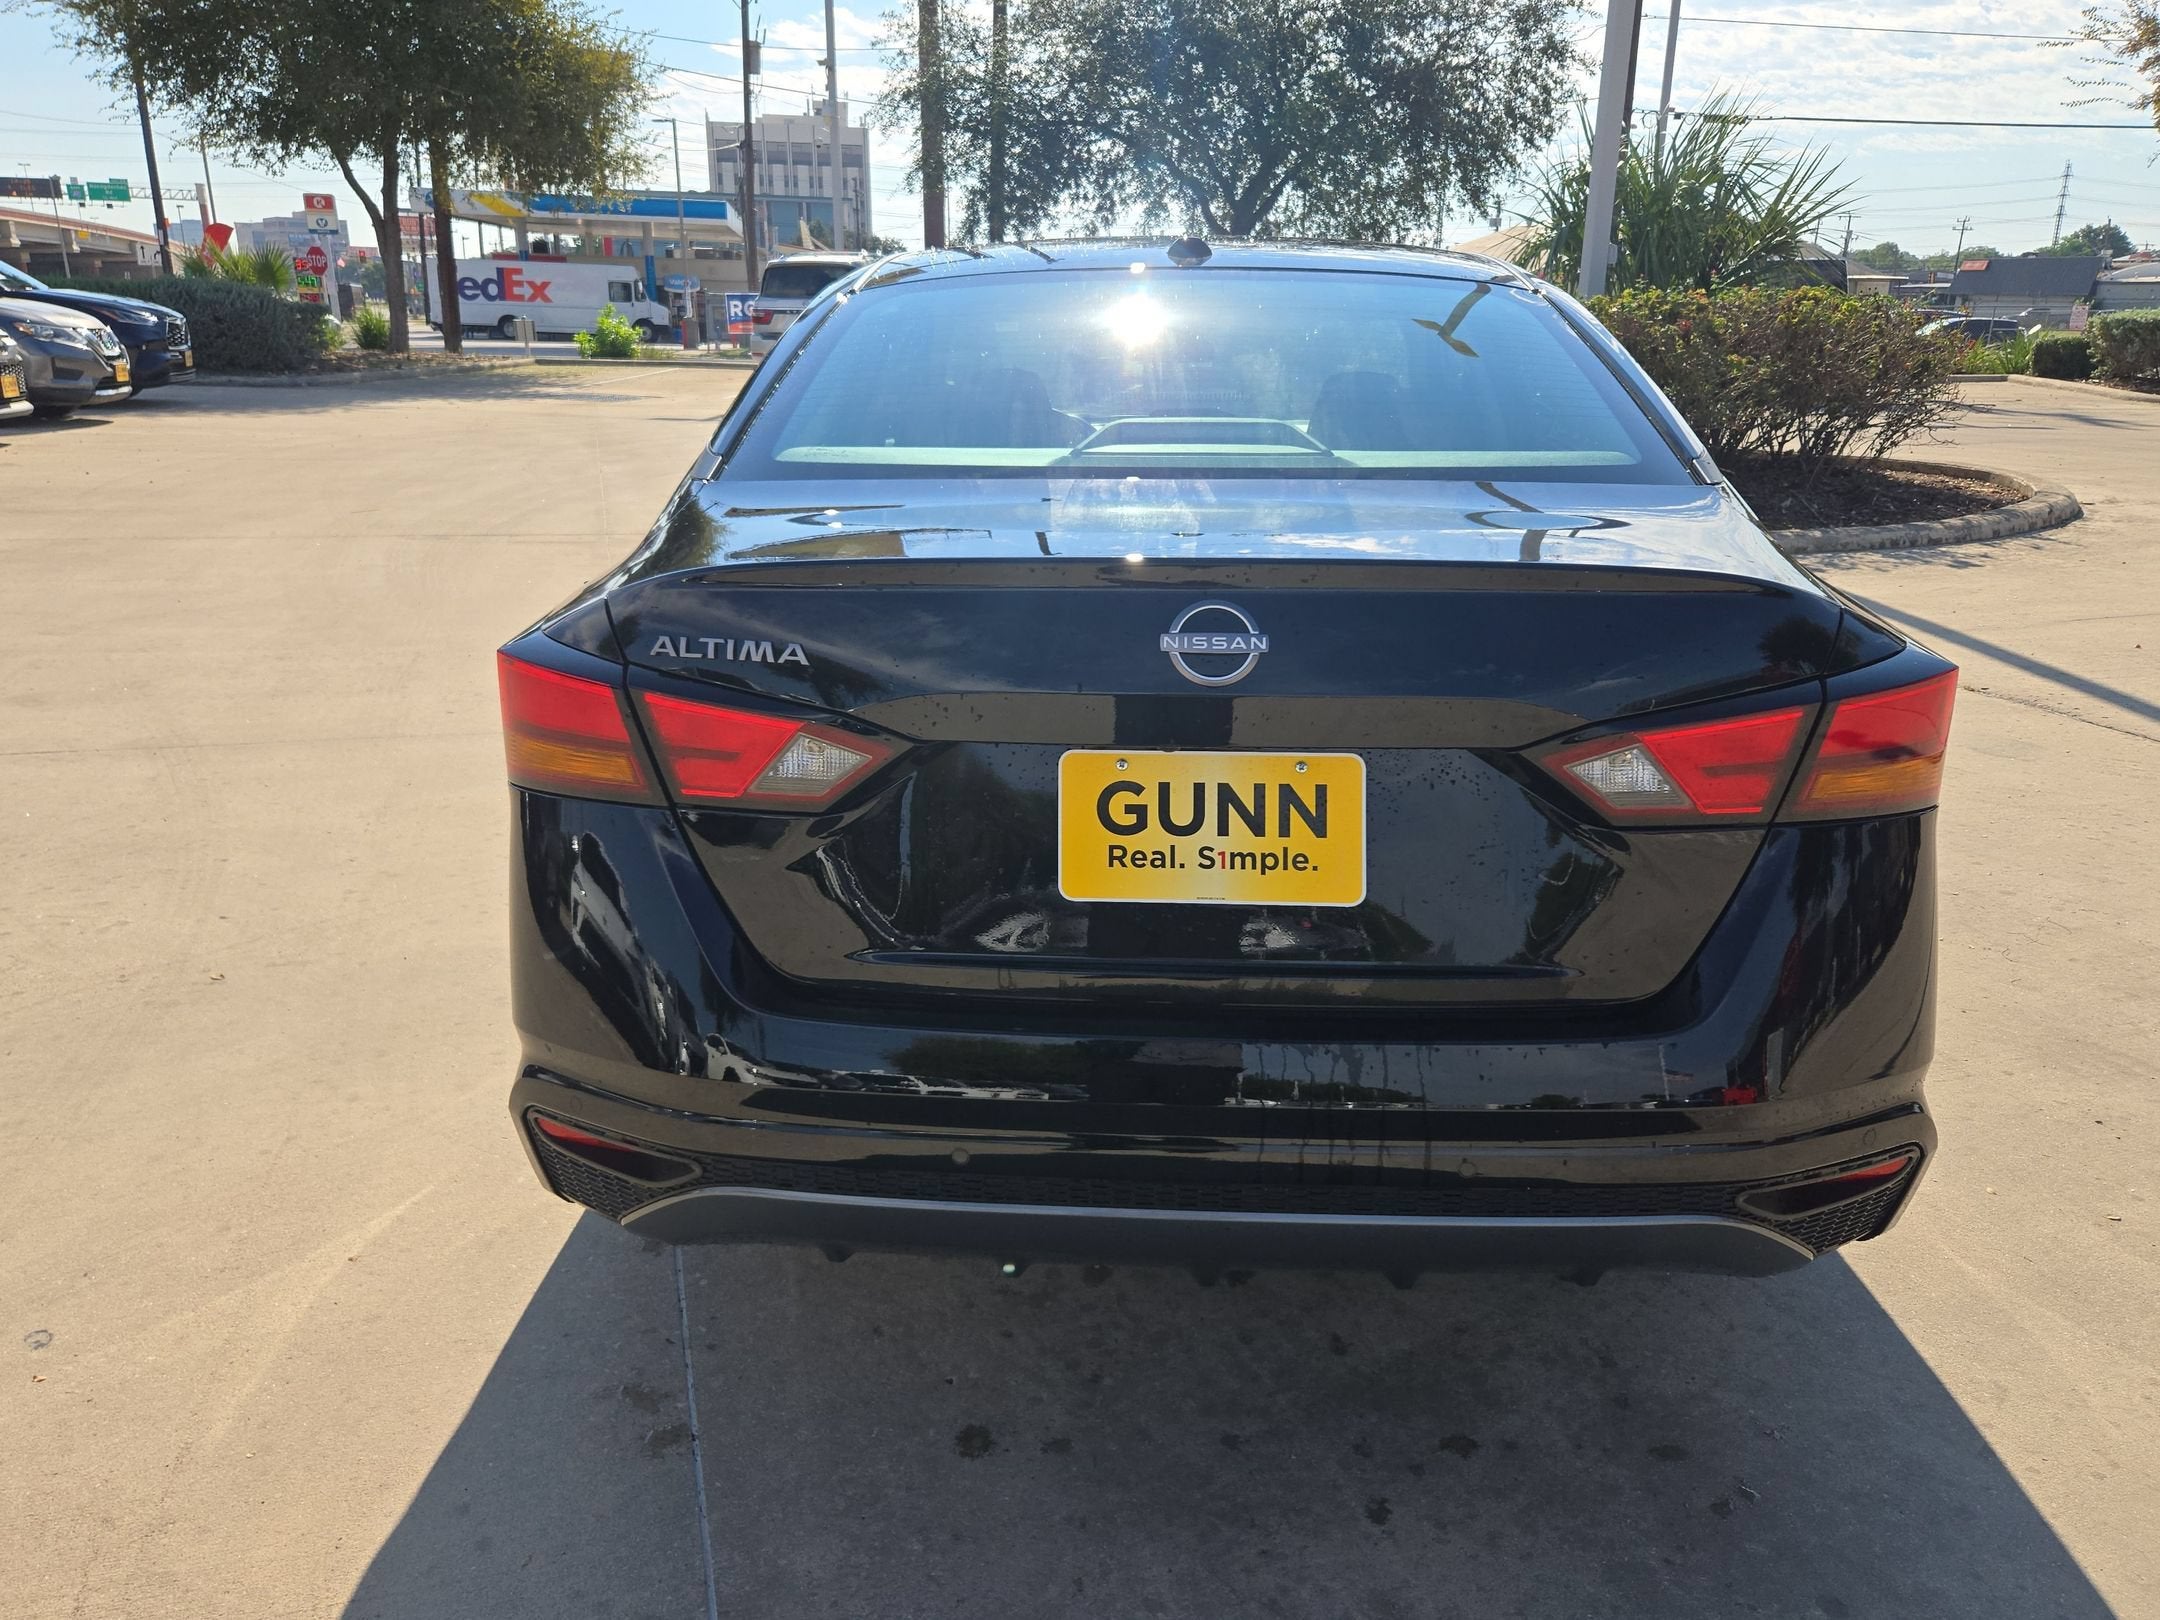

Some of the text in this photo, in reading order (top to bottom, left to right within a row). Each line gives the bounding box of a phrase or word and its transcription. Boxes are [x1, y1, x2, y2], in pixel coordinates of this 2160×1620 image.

[308, 255, 327, 268] STOP
[457, 267, 553, 303] edEx
[650, 635, 810, 666] ALTIMA
[1163, 634, 1268, 652] NISSAN
[1096, 780, 1328, 838] GUNN
[1108, 844, 1186, 869] Real.
